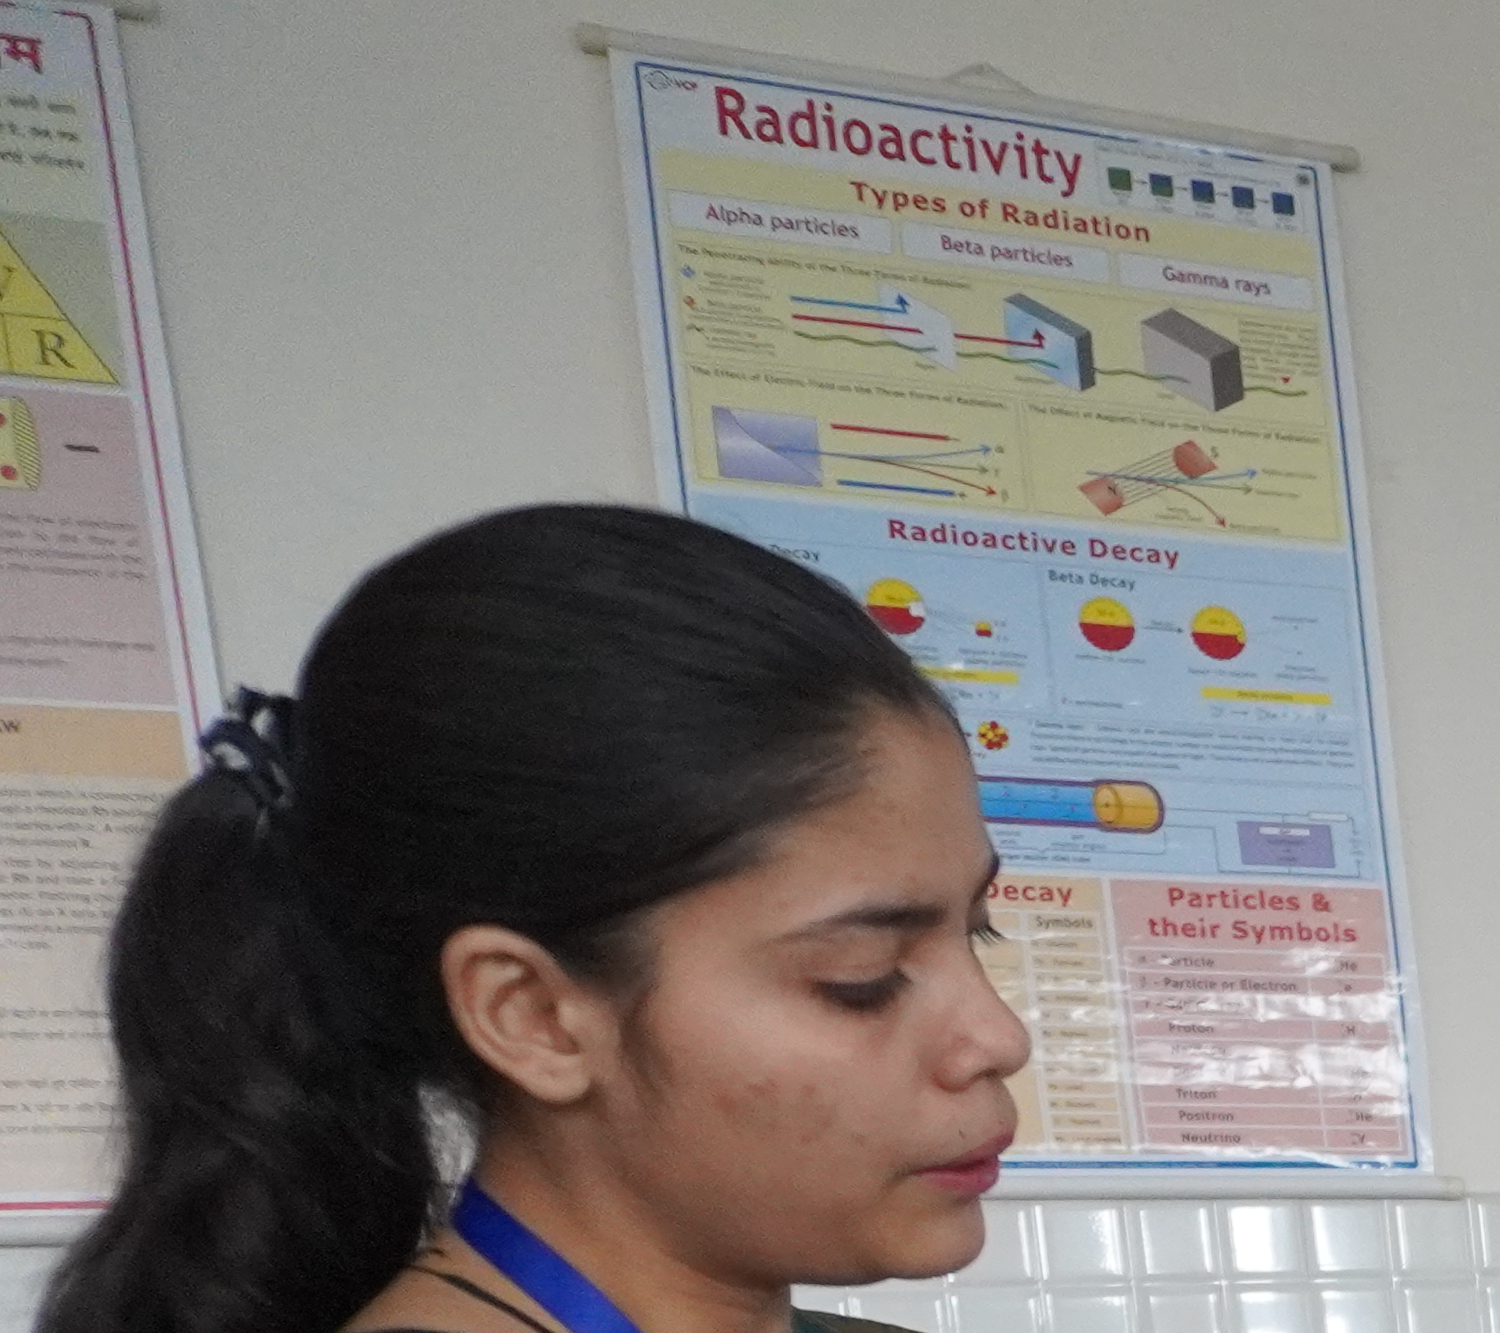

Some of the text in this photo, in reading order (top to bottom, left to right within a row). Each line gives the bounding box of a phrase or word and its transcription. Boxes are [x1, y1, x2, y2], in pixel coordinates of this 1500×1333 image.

[714, 85, 1082, 197] Radioactivity
[705, 203, 860, 239] Alpha particles
[851, 180, 1151, 243] Types of Radiation
[941, 234, 1074, 270] Beta particles
[1162, 265, 1271, 297] Gamma rays
[31, 329, 77, 369] R
[888, 518, 1180, 569] Radioactive Decay
[1047, 569, 1136, 592] Beta Decay
[1168, 886, 1332, 913] Particles &
[1034, 914, 1094, 930] Symbols
[1148, 916, 1358, 946] their Symbols
[1163, 976, 1217, 990] Particle
[1239, 978, 1297, 992] Electron
[1176, 1087, 1218, 1100] Triton
[1178, 1110, 1235, 1122] Positron
[1181, 1131, 1242, 1144] Neutrino
